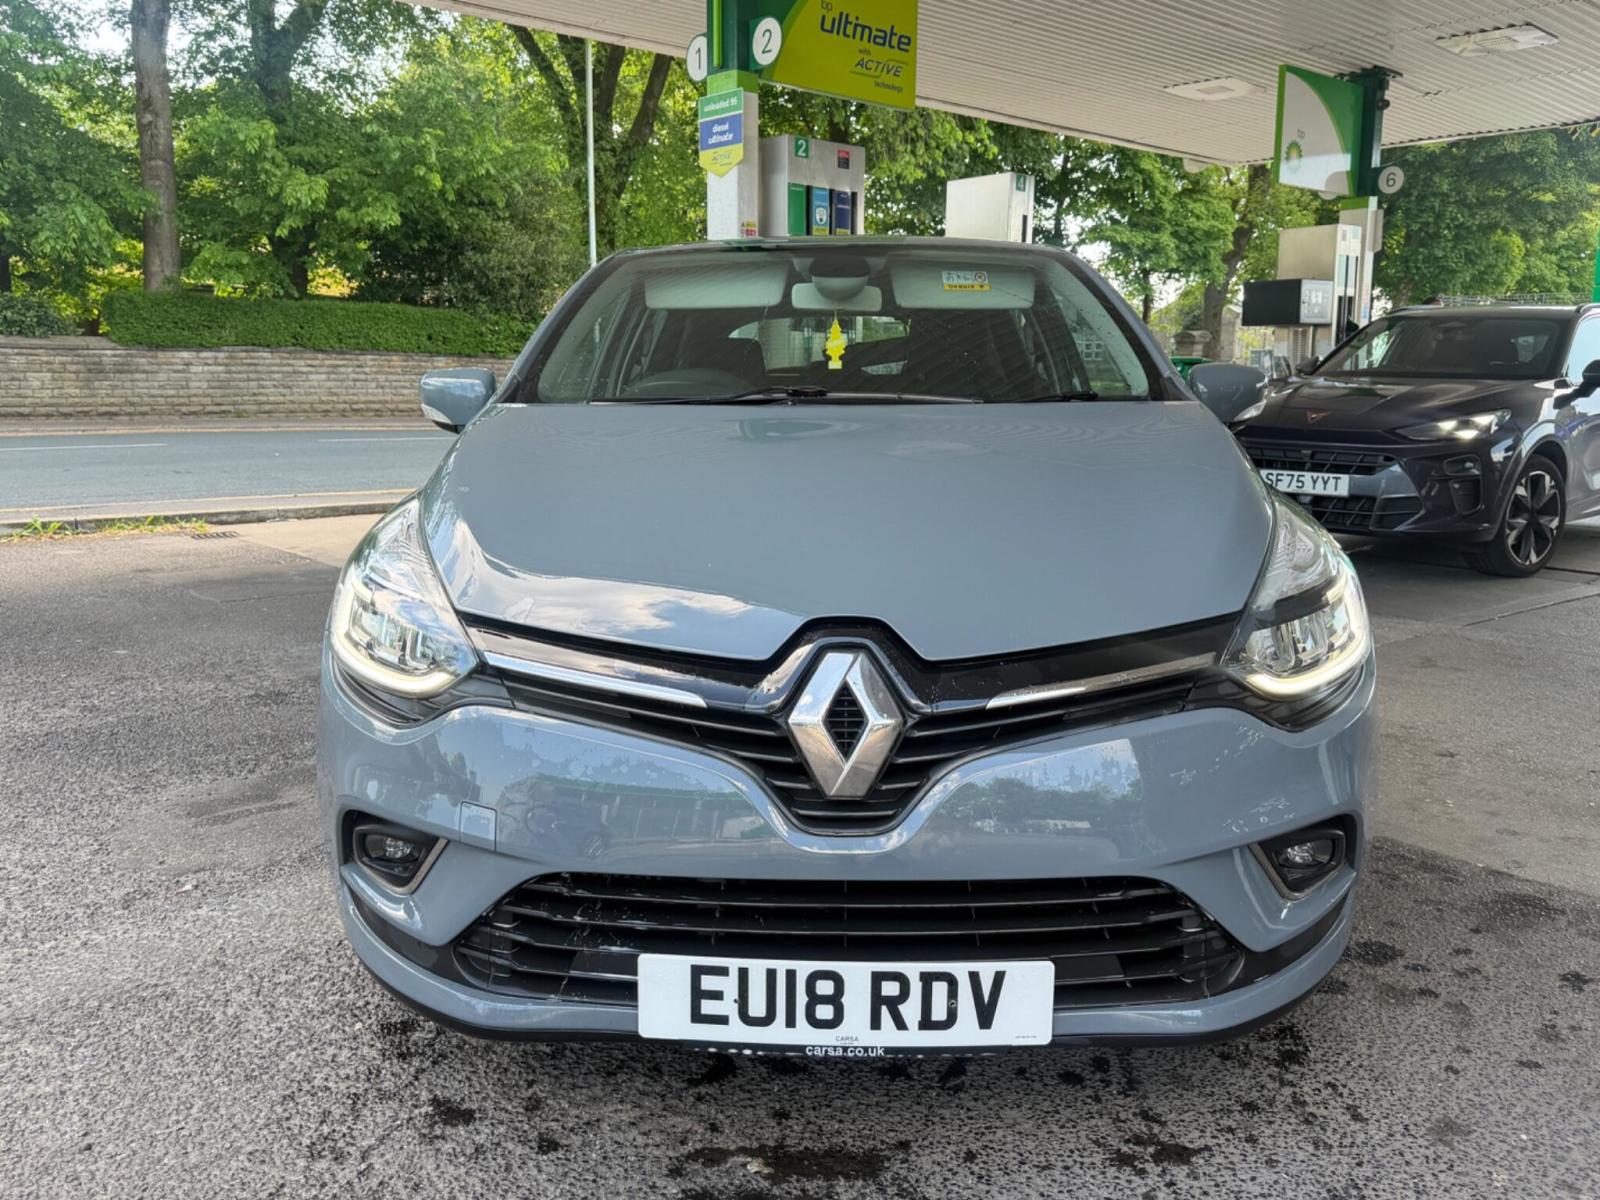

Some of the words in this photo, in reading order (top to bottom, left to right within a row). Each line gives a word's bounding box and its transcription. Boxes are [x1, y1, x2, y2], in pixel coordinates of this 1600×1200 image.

[821, 0, 833, 12] bp
[761, 28, 773, 54] 2
[820, 11, 912, 53] ultimate
[695, 47, 702, 71] 1
[854, 57, 903, 78] ACTIVE
[712, 121, 729, 133] diesel
[708, 132, 734, 144] ultimate
[797, 139, 807, 157] 2
[1386, 172, 1396, 187] 6
[1265, 472, 1305, 489] SF75
[1310, 475, 1342, 492] YYT
[690, 964, 845, 1030] EU18
[870, 970, 1006, 1031] RDV
[805, 1046, 885, 1057] carsa.co.uk
